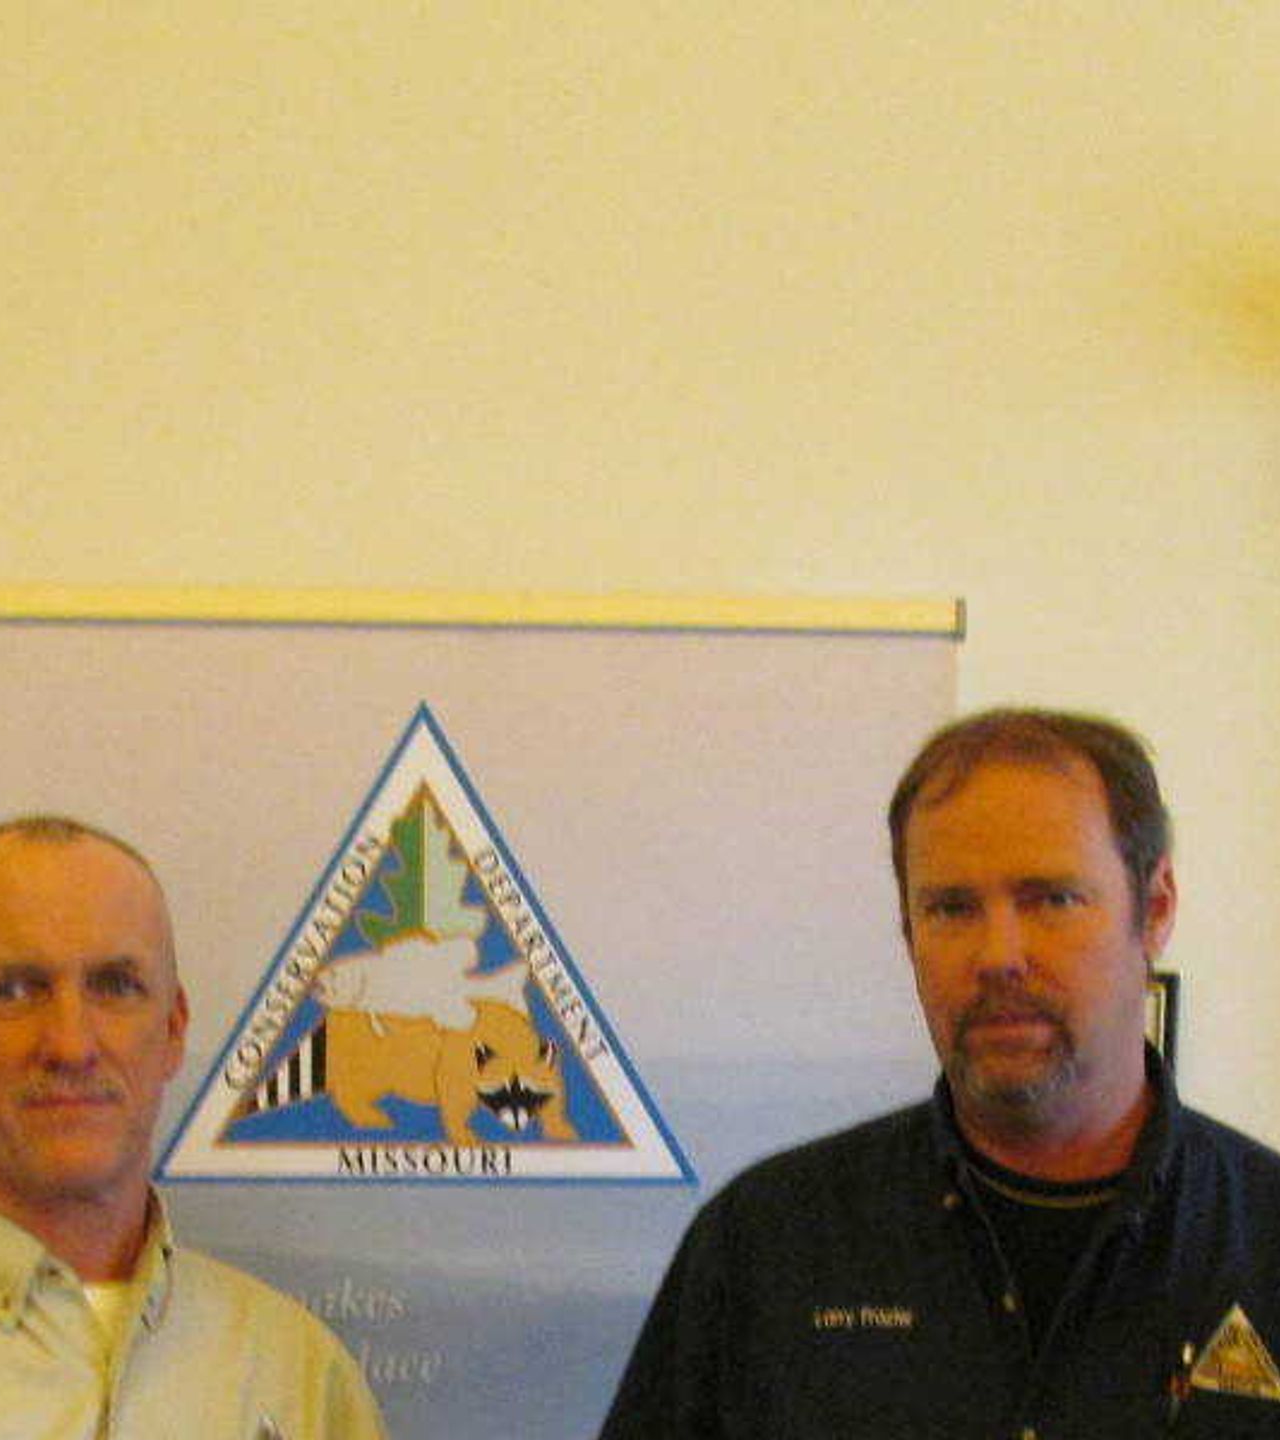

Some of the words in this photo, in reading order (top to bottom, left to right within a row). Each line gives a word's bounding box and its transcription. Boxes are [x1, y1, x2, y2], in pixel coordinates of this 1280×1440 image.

[224, 833, 381, 1091] CONSERVATION
[476, 847, 609, 1061] DEPARTMENT
[336, 1148, 513, 1175] MISSOURI
